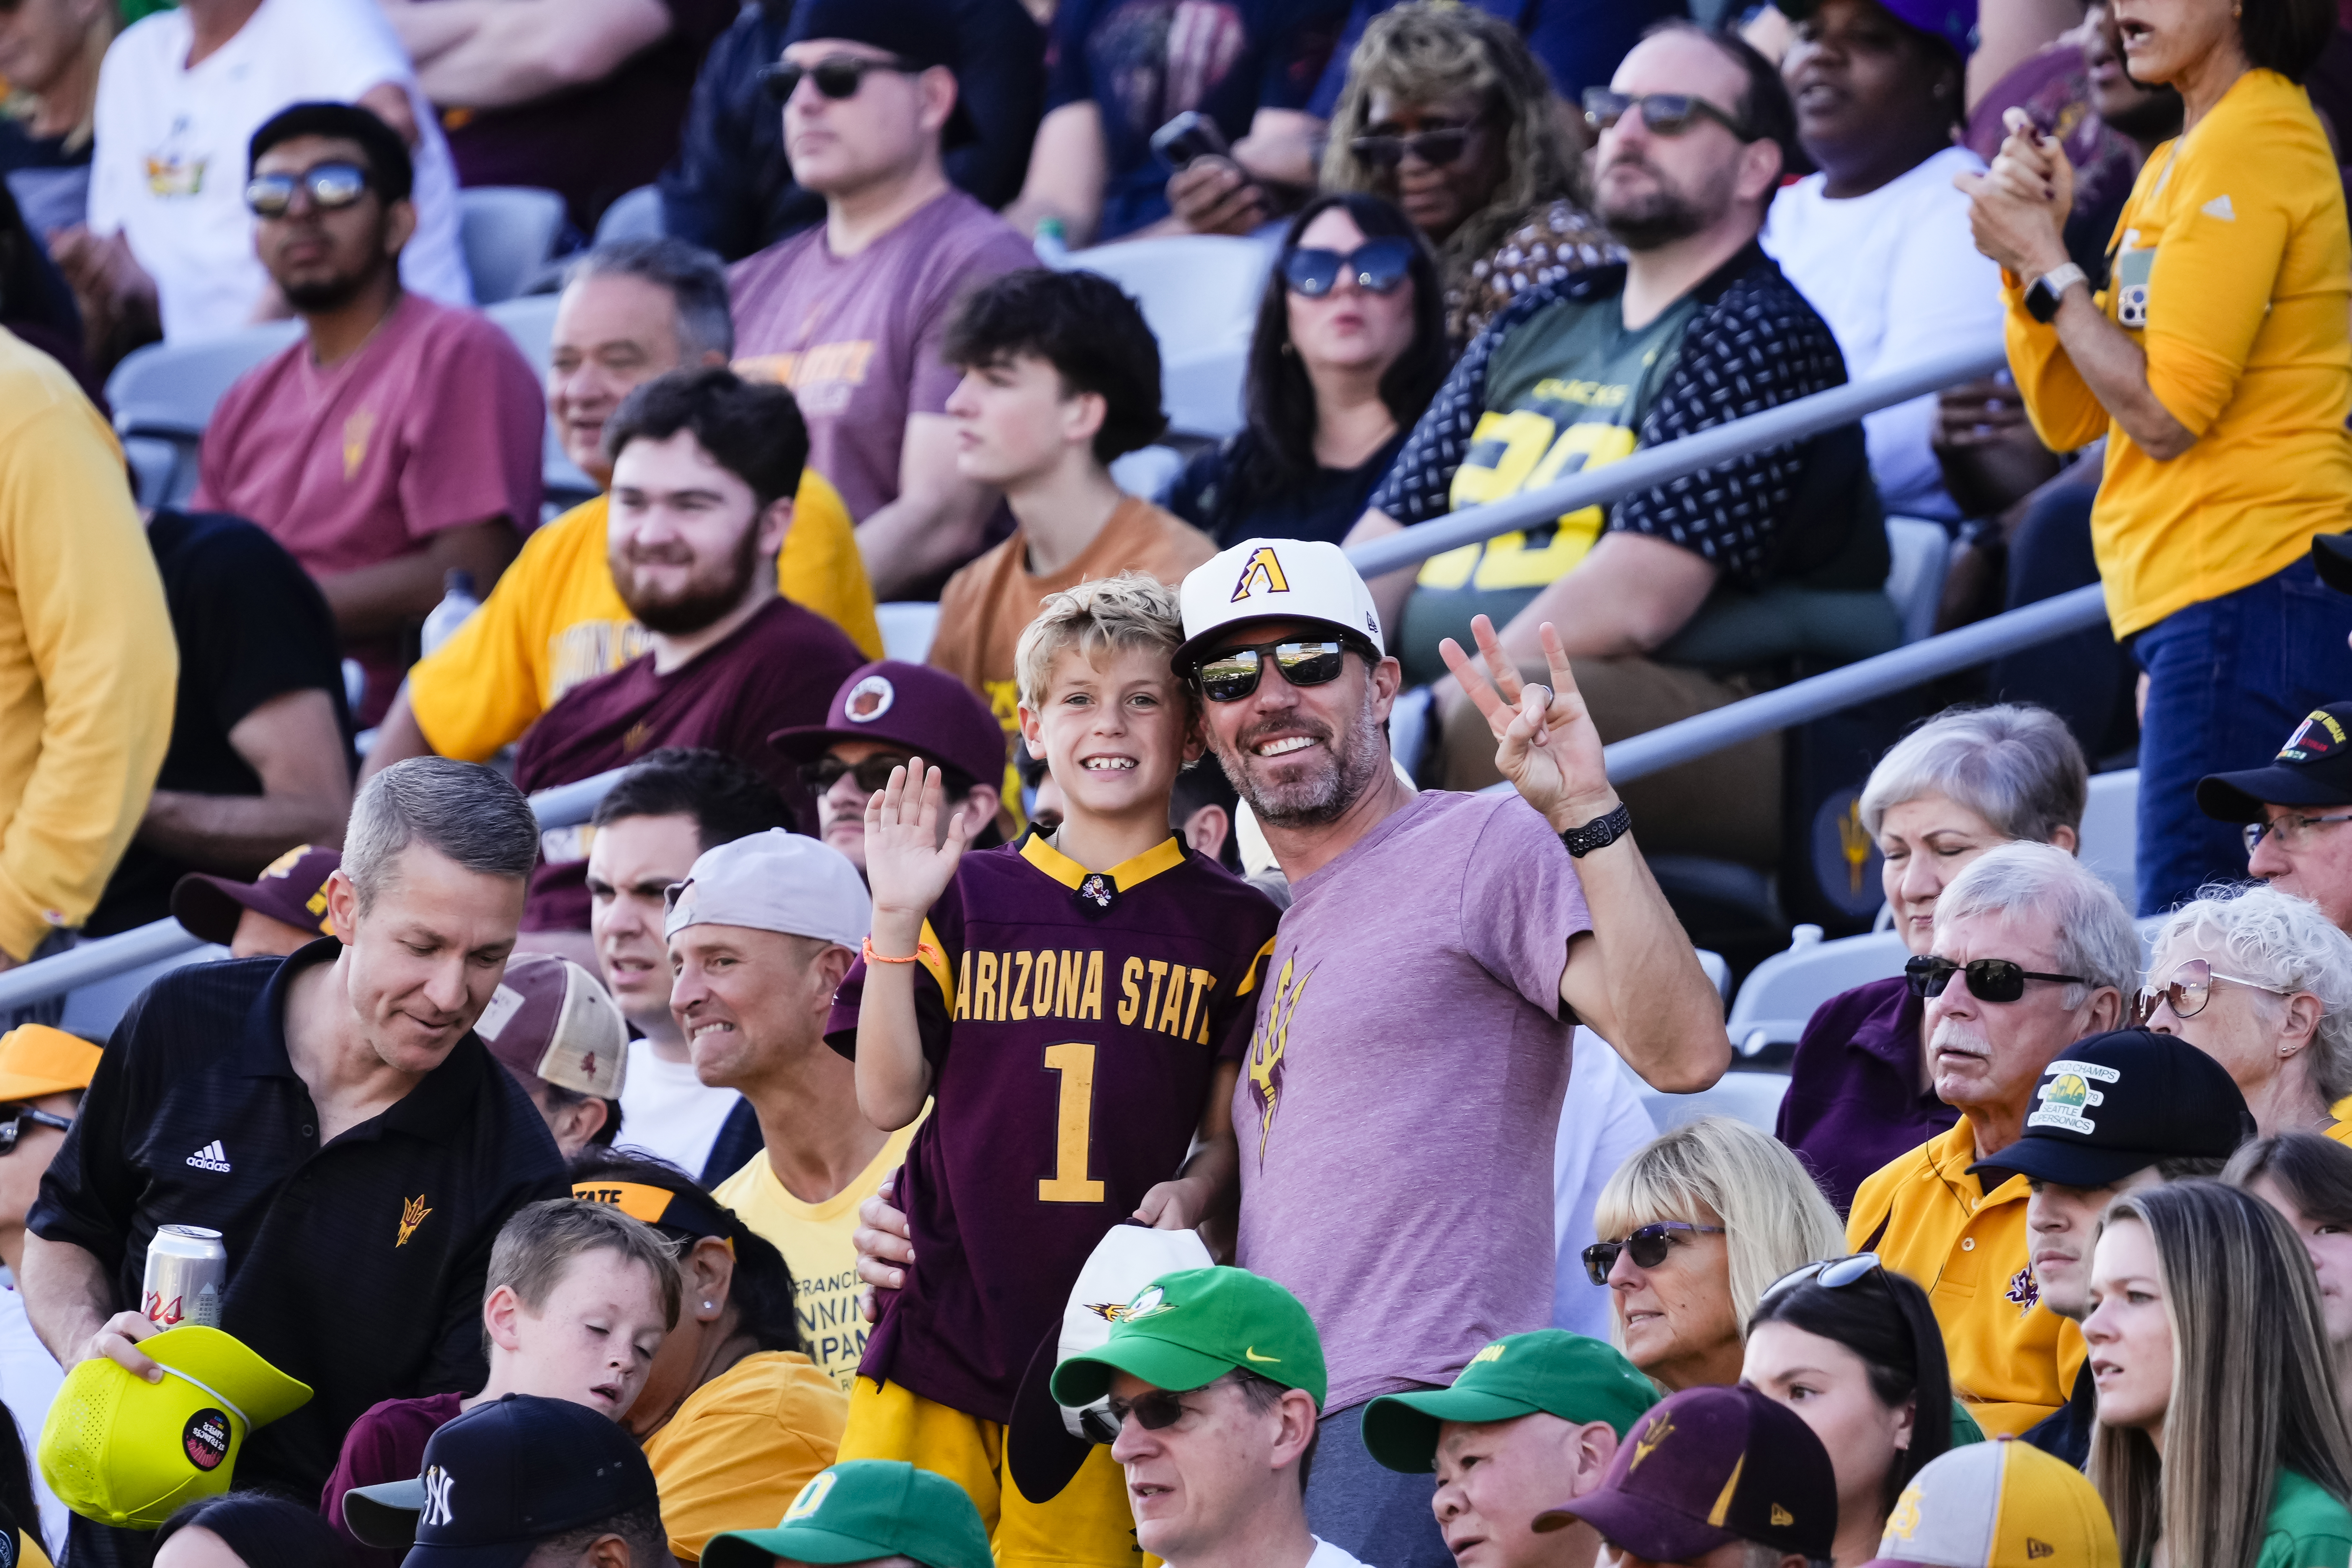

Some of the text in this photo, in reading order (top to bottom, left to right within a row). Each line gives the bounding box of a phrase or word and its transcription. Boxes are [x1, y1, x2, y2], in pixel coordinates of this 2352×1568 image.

[953, 949, 1104, 1022] ARIZONA
[2073, 1064, 2116, 1080] CHAMPS
[2088, 1092, 2099, 1102] 79
[2043, 1105, 2079, 1117] SEATTLE
[1038, 1043, 1105, 1202] 1
[2030, 1114, 2090, 1130] SUPERSONICS
[186, 1157, 230, 1172] adidas
